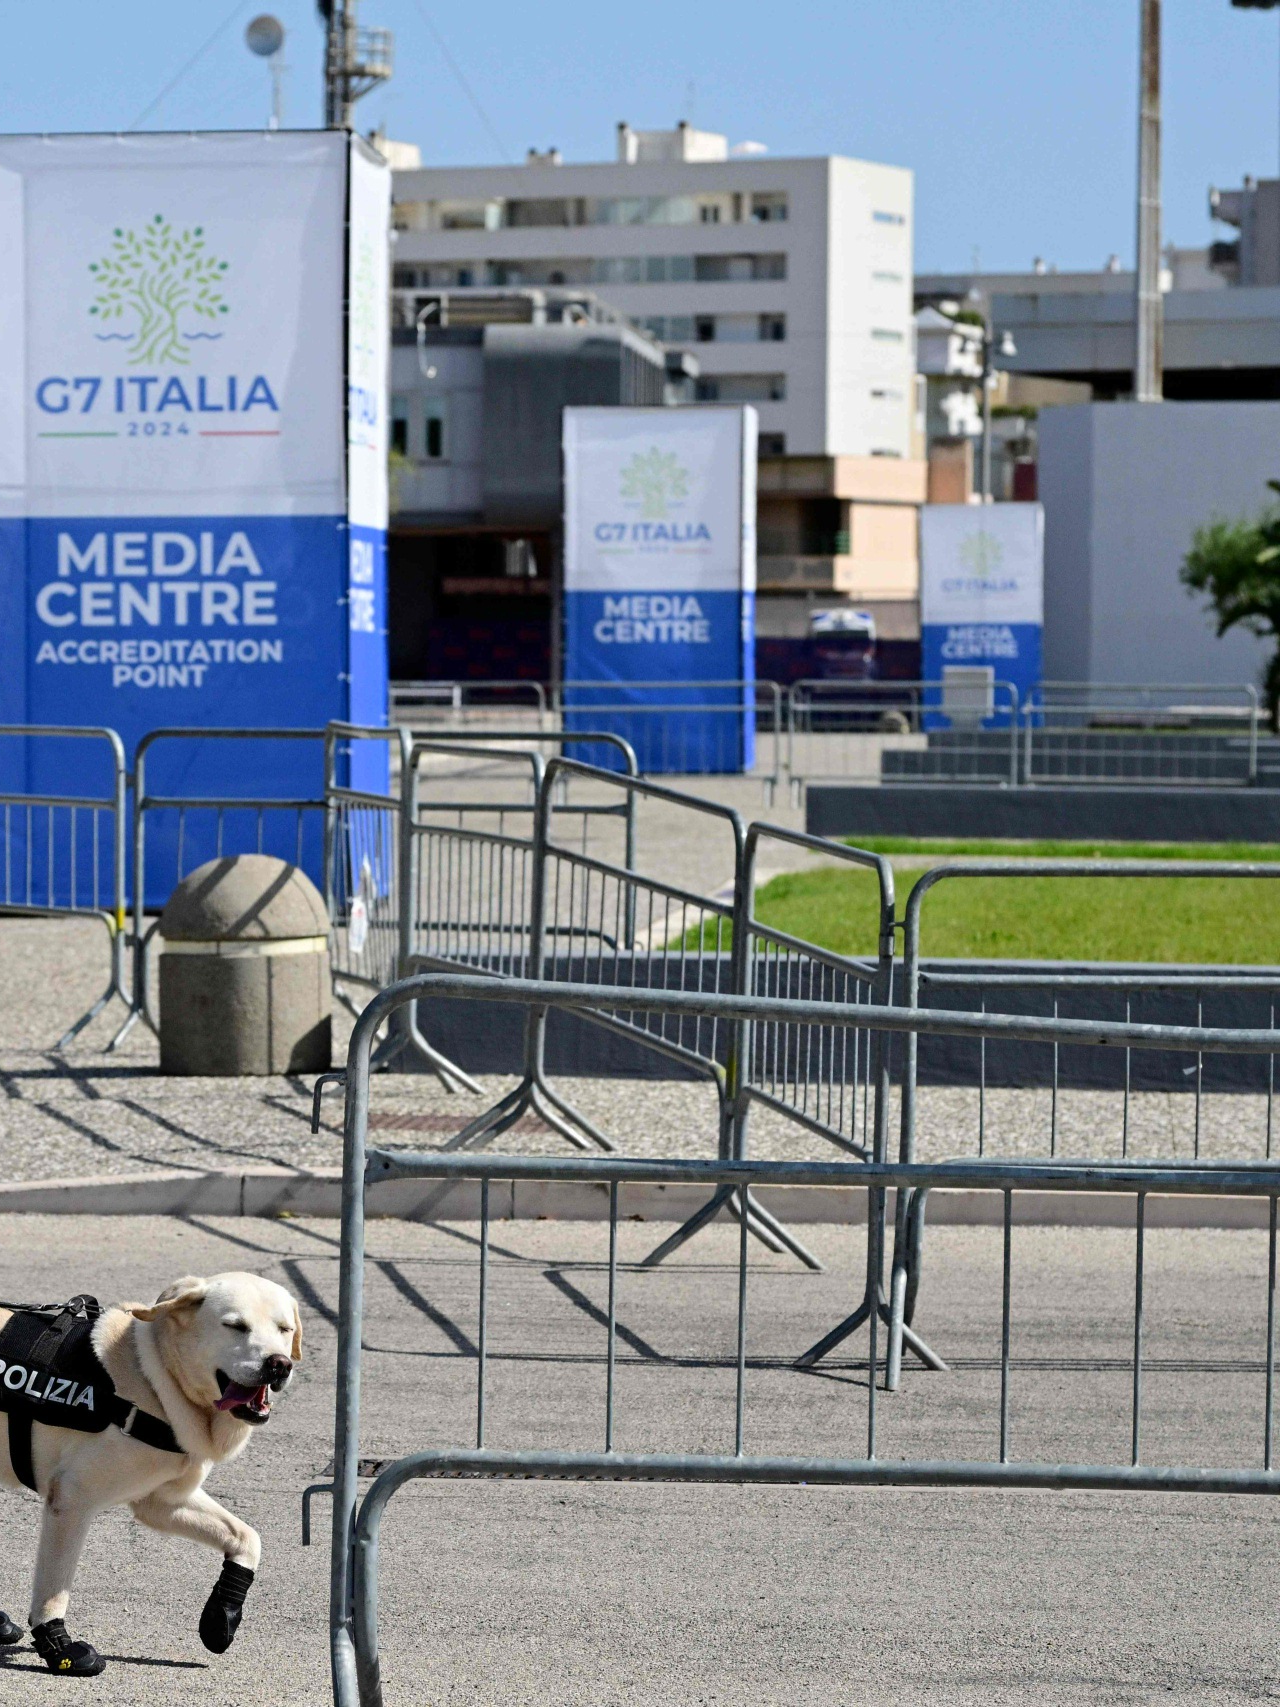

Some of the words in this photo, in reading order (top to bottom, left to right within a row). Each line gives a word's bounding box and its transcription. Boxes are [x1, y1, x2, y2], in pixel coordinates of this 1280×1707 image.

[35, 376, 102, 414] G7
[115, 375, 279, 413] ITALIA
[127, 421, 190, 437] 2024
[594, 522, 627, 542] G7
[632, 522, 711, 542] ITALIA
[57, 532, 263, 576] MEDIA
[35, 581, 278, 627] CENTRE
[603, 595, 703, 618] MEDIA
[593, 619, 710, 643] CENTRE
[35, 639, 283, 665] ACCREDITATION
[113, 664, 208, 688] POINT
